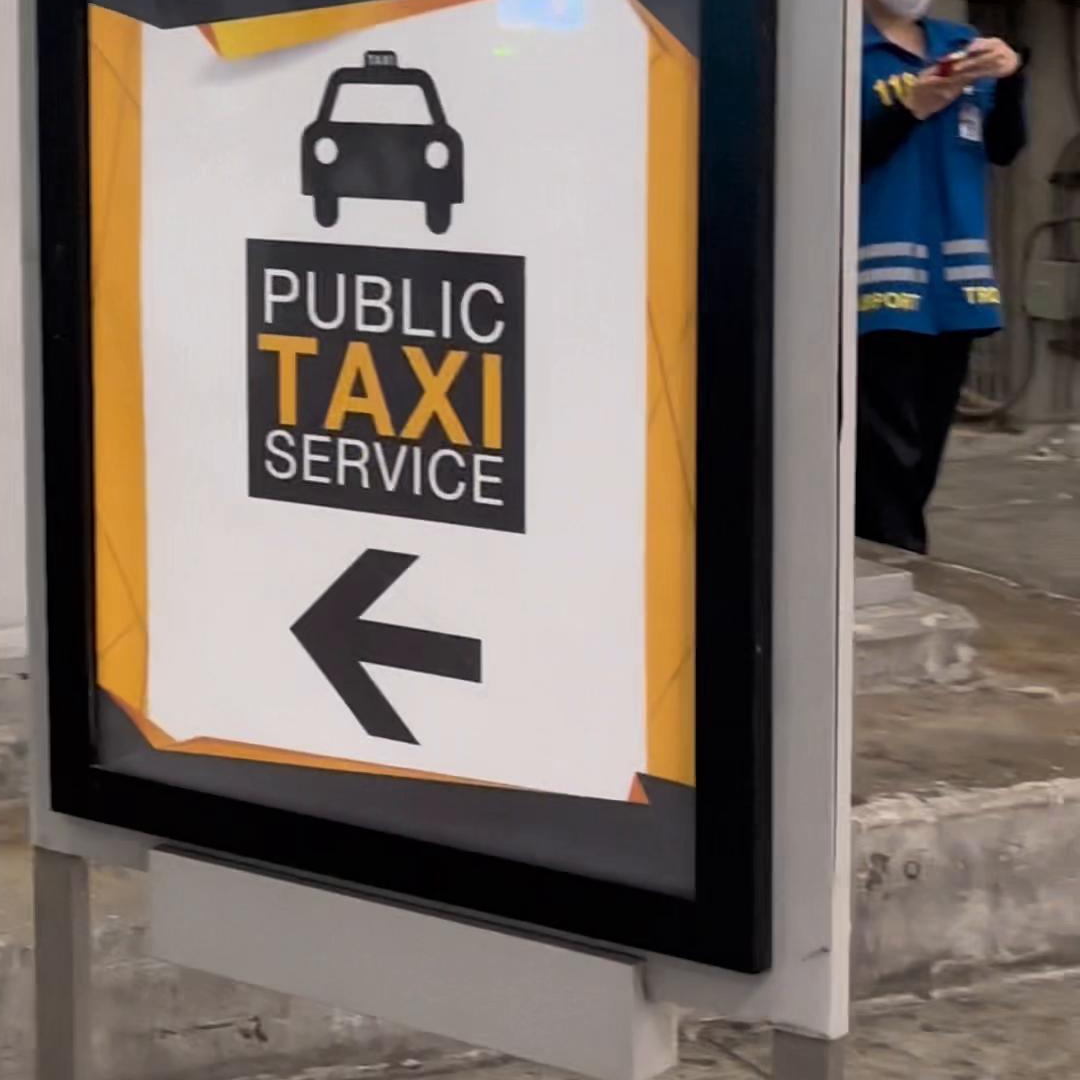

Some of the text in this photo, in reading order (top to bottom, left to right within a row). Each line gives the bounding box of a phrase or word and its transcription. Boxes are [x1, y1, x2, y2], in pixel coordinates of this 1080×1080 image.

[263, 268, 505, 344] PUBLIC
[257, 333, 503, 450] TAXI
[264, 429, 505, 506] SERVICE
